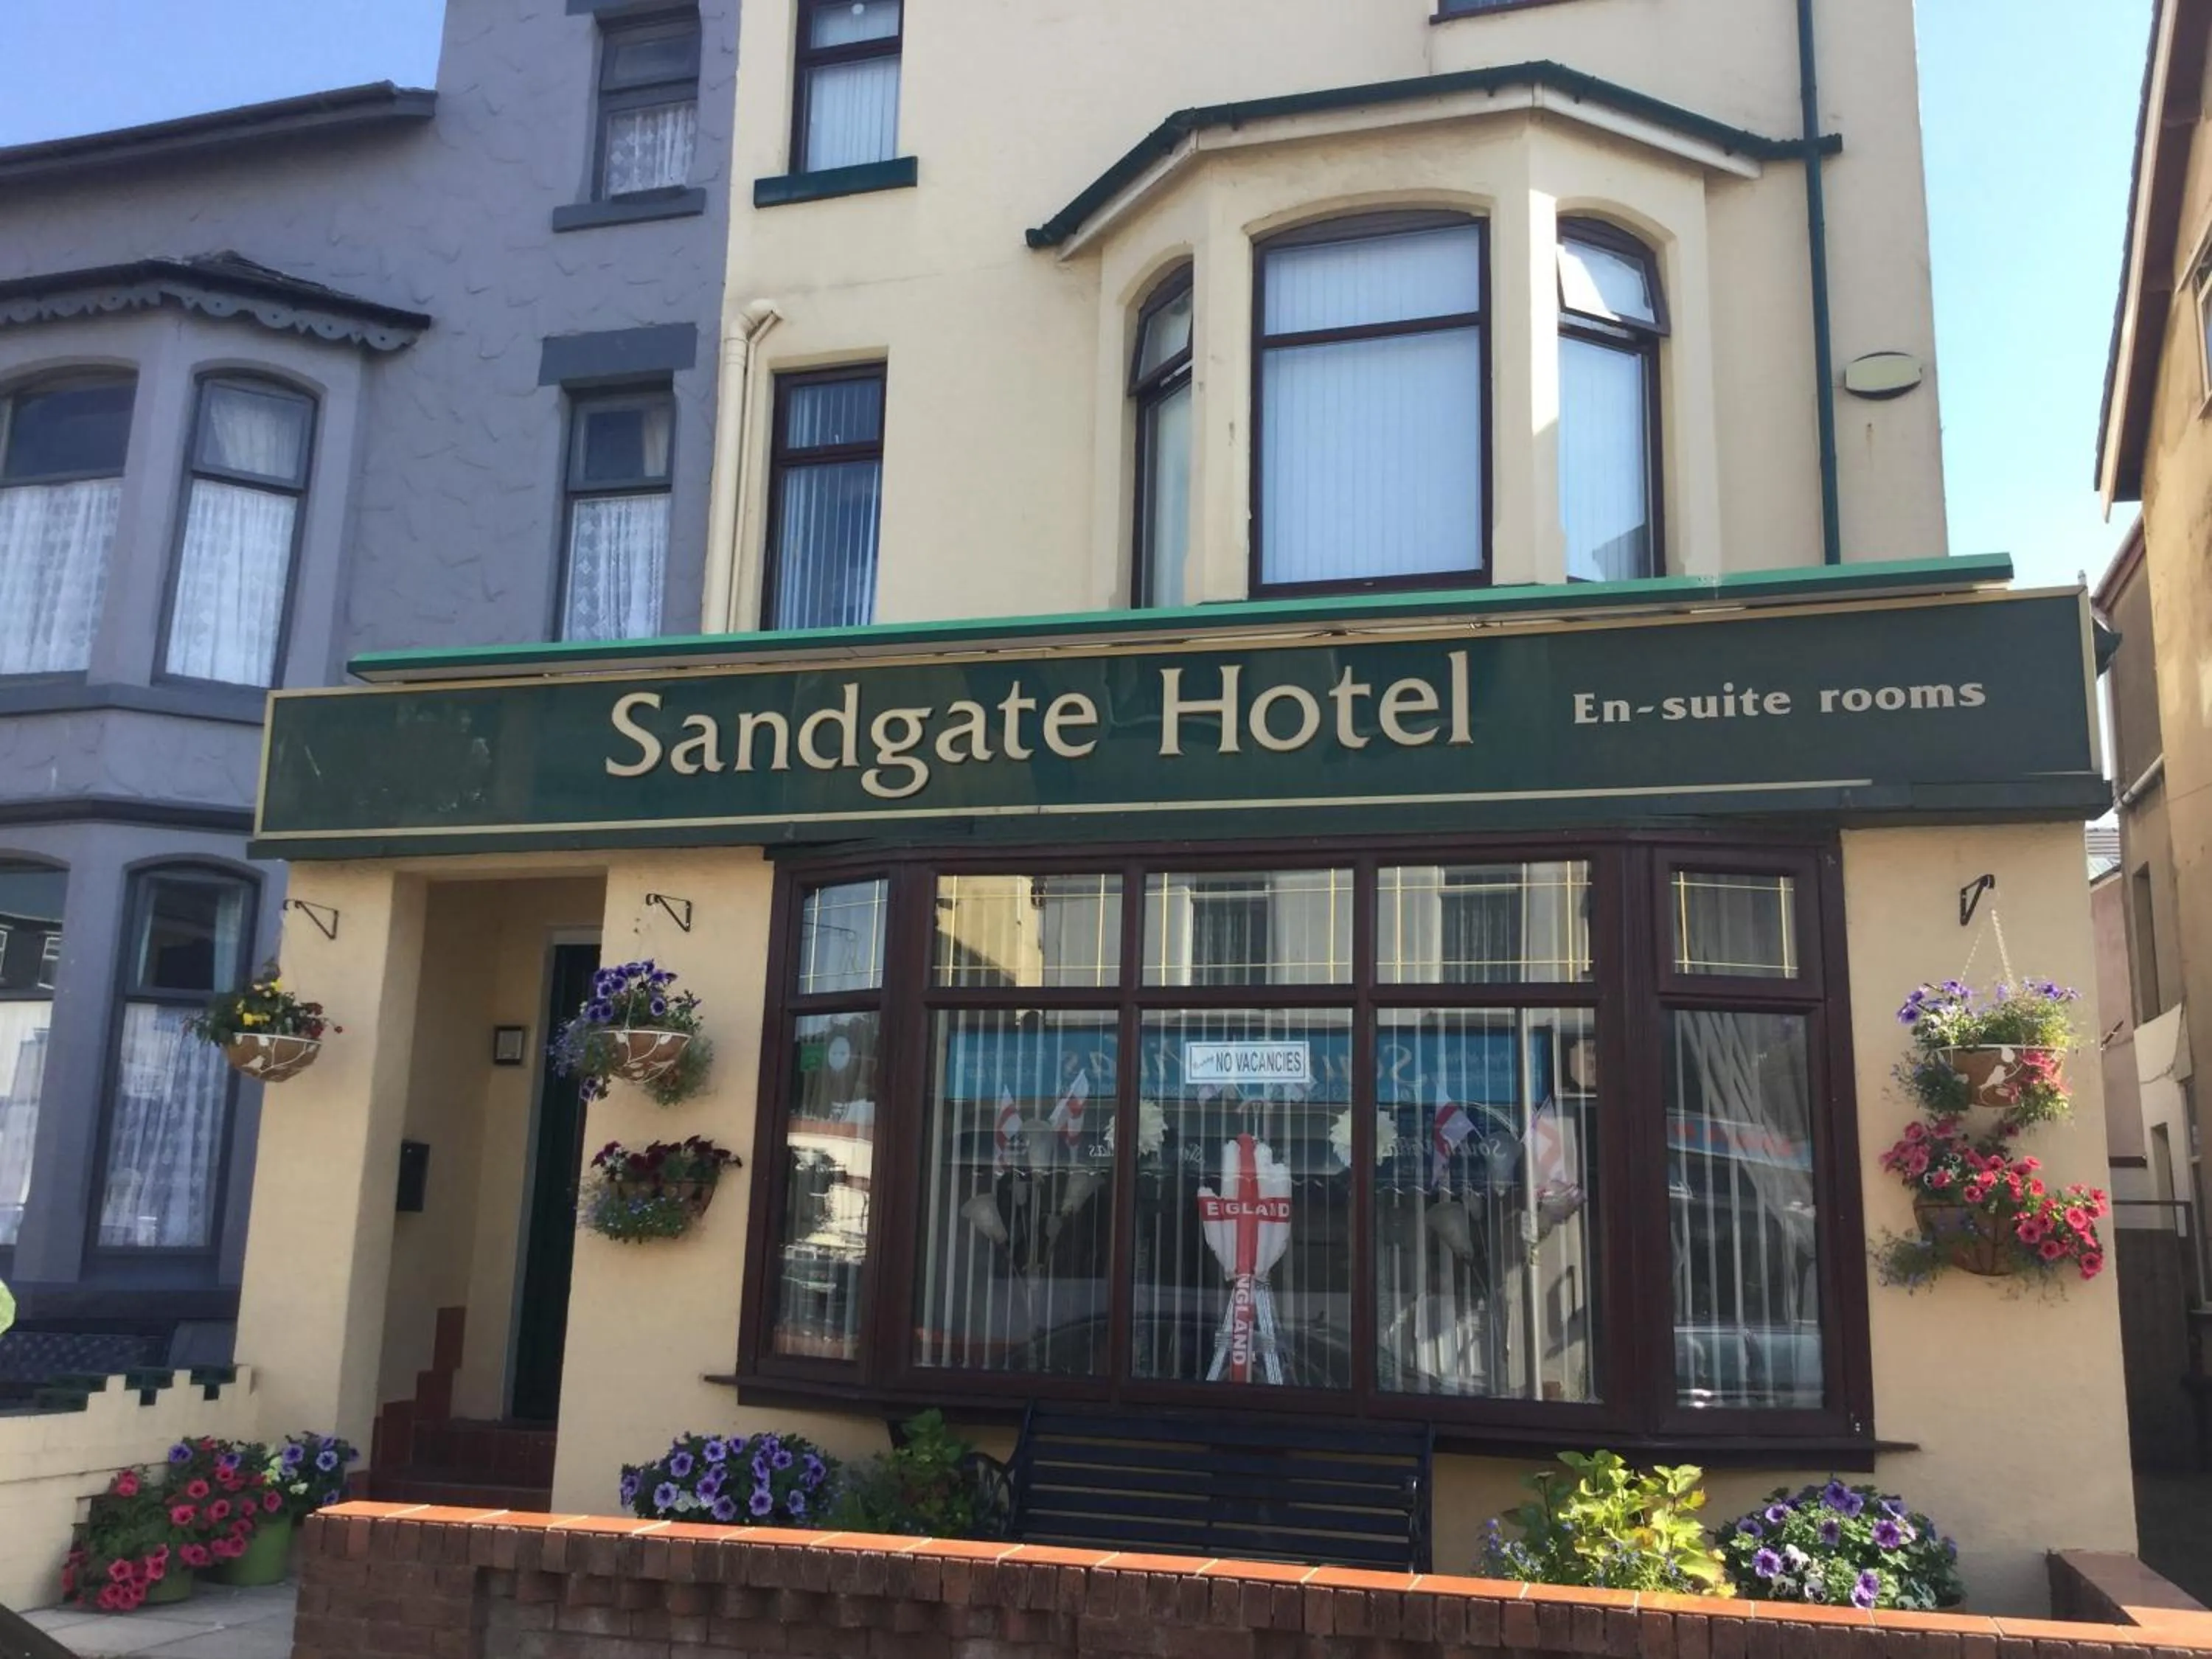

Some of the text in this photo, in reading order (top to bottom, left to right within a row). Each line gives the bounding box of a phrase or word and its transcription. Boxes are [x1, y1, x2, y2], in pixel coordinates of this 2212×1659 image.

[605, 650, 1986, 799] Sandgate Hotel En-suite rooms
[1216, 1051, 1232, 1072] NO
[1236, 1051, 1301, 1072] VACANCIES
